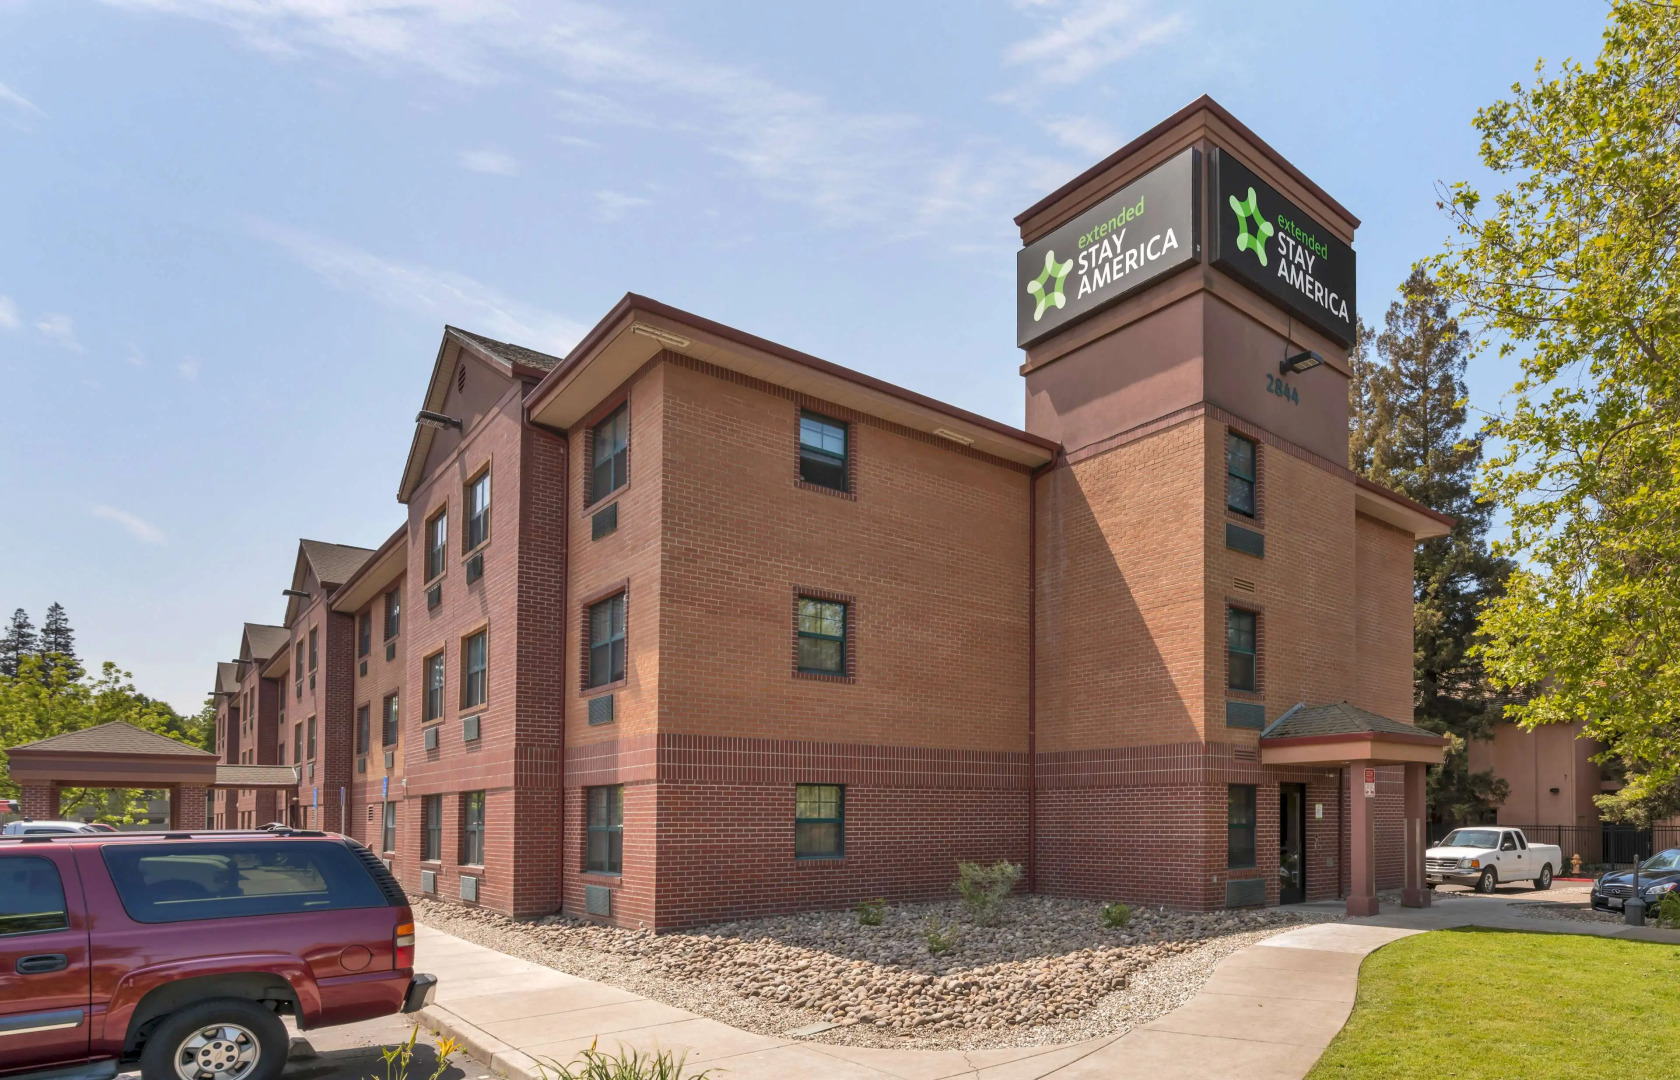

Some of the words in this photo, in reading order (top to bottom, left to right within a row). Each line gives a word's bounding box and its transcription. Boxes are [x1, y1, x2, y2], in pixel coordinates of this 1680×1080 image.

[1078, 195, 1144, 249] extended
[1277, 213, 1328, 261] extended
[1077, 228, 1178, 299] AMERICA
[1078, 228, 1127, 275] STAY
[1278, 231, 1316, 274] STAY
[1278, 261, 1349, 323] AMERICA
[1266, 373, 1299, 406] 2844
